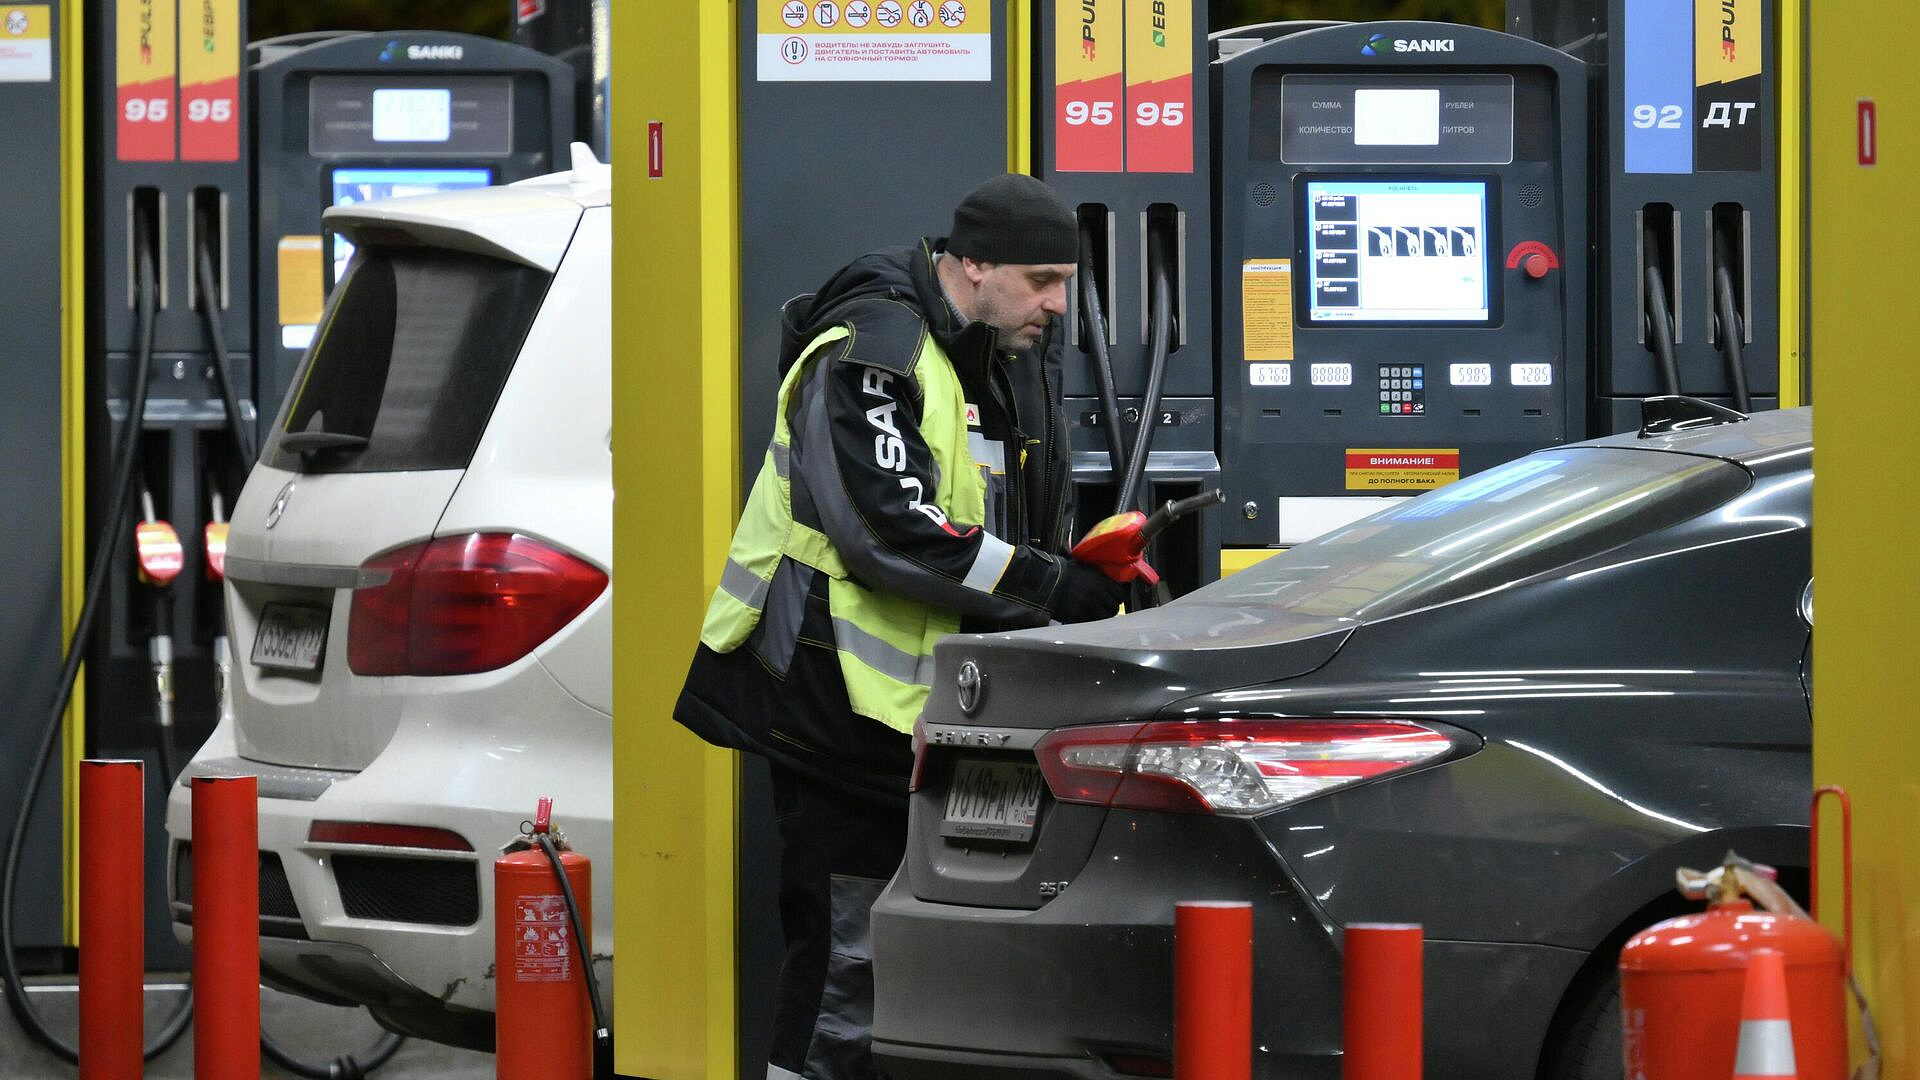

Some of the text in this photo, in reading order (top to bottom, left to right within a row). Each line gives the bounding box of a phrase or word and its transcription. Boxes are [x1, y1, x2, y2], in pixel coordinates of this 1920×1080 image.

[407, 44, 463, 60] SANKI
[1393, 39, 1455, 52] SANKI
[125, 98, 168, 122] 95
[188, 98, 232, 122] 95
[1311, 101, 1342, 109] СУММА
[1445, 101, 1474, 109] РУБЛЕЙ
[1065, 101, 1114, 126] 95
[1136, 102, 1185, 127] 95
[1632, 104, 1683, 129] 92
[1702, 102, 1756, 129] ДТ
[1299, 126, 1353, 134] КОЛИЧЕСТВО
[1442, 126, 1475, 134] ЛИТРОВ
[1258, 367, 1289, 383] 6760
[1090, 413, 1097, 425] 1
[1163, 413, 1172, 424] 2
[863, 366, 948, 528] PUSAR
[1370, 457, 1435, 465] ВНИМАНИЕ!
[1011, 767, 1041, 808] 790
